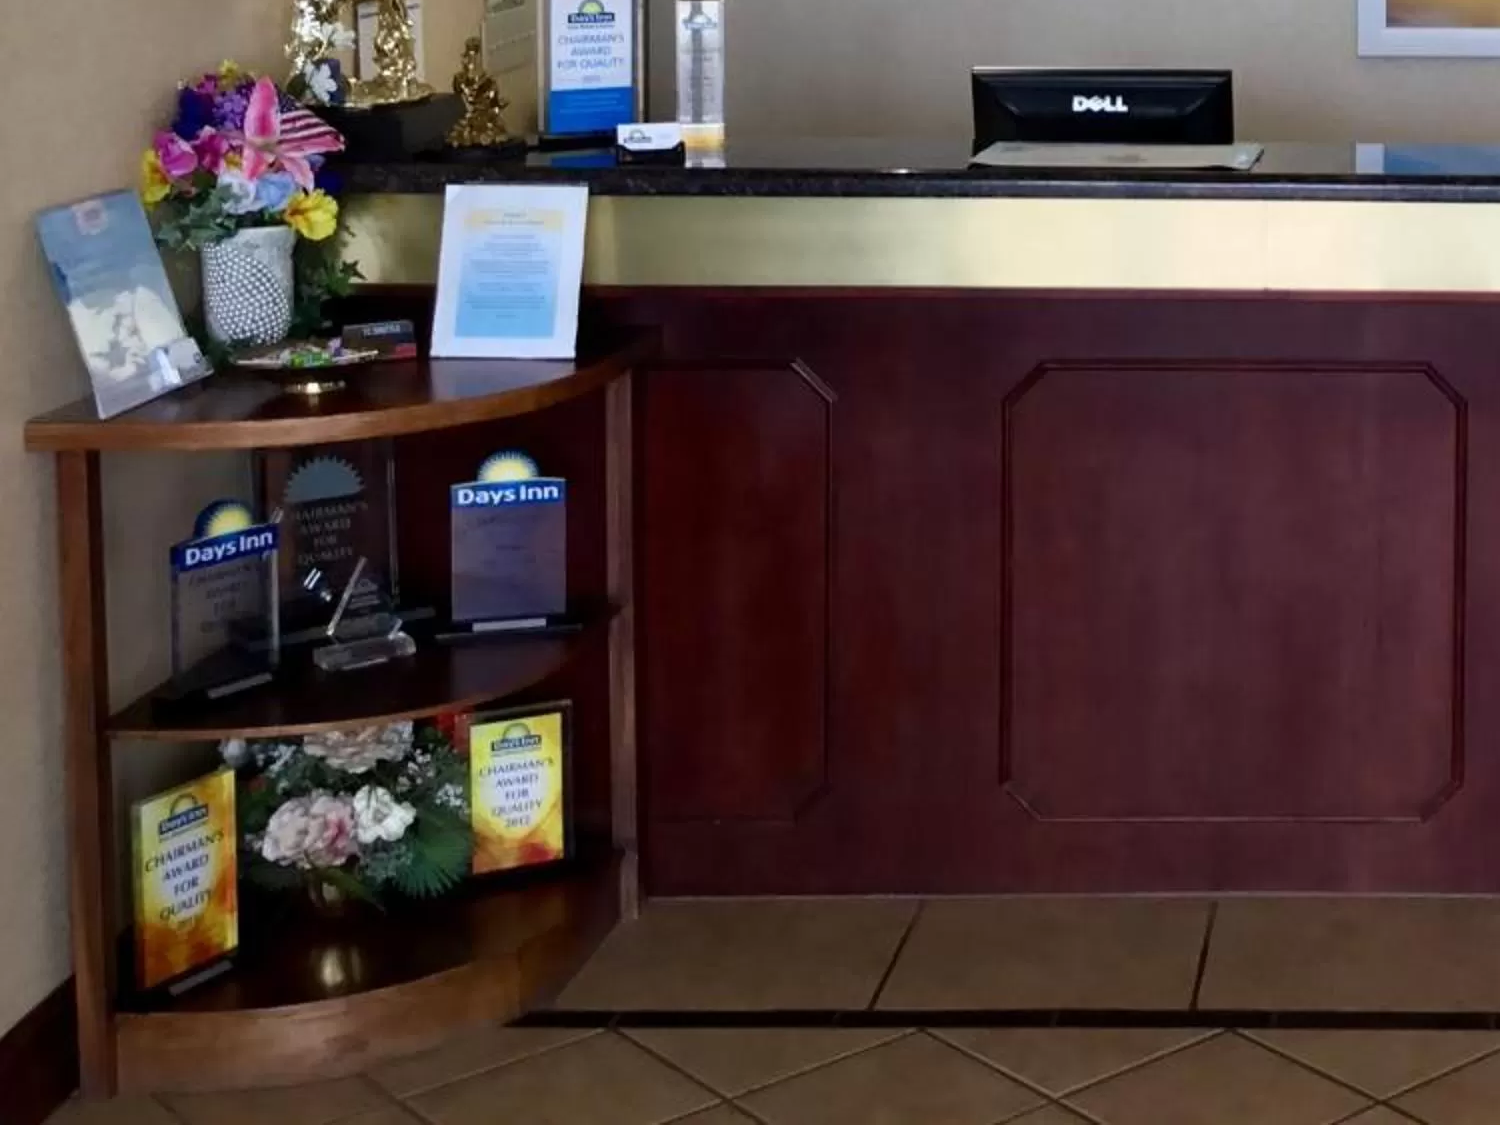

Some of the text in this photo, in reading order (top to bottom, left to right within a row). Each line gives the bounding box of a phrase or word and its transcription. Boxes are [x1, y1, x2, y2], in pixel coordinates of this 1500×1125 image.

[1072, 95, 1128, 112] DELL
[458, 484, 560, 506] Days Inn
[185, 532, 273, 566] Days Inn
[479, 757, 555, 776] CHAIRMAN'S
[496, 774, 539, 788] AWARD
[505, 788, 530, 801] FOR
[490, 798, 542, 816] QUALITY
[163, 854, 209, 881] AWARD
[173, 876, 199, 896] FOR
[160, 889, 211, 921] QUALITY
